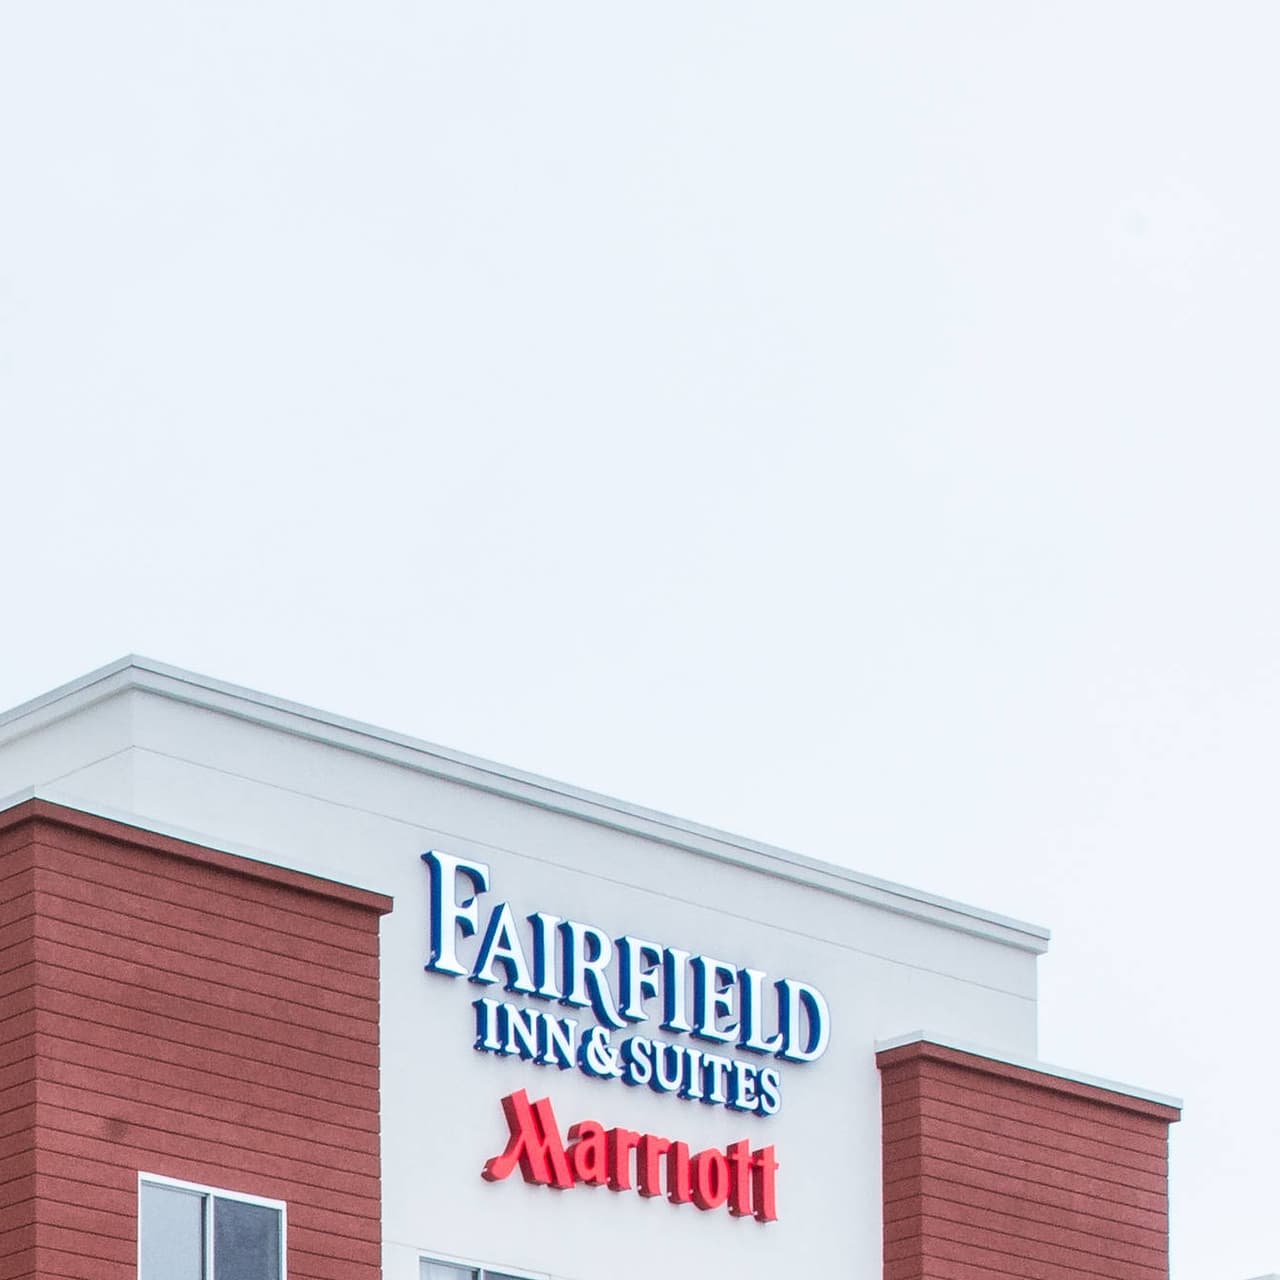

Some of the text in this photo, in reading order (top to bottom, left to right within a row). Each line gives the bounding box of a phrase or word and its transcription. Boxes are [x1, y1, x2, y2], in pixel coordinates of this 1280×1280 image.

[420, 849, 831, 1064] FAIRFIELD
[472, 997, 577, 1069] INN
[622, 1035, 782, 1117] SUITES
[481, 1088, 779, 1223] Marriott
